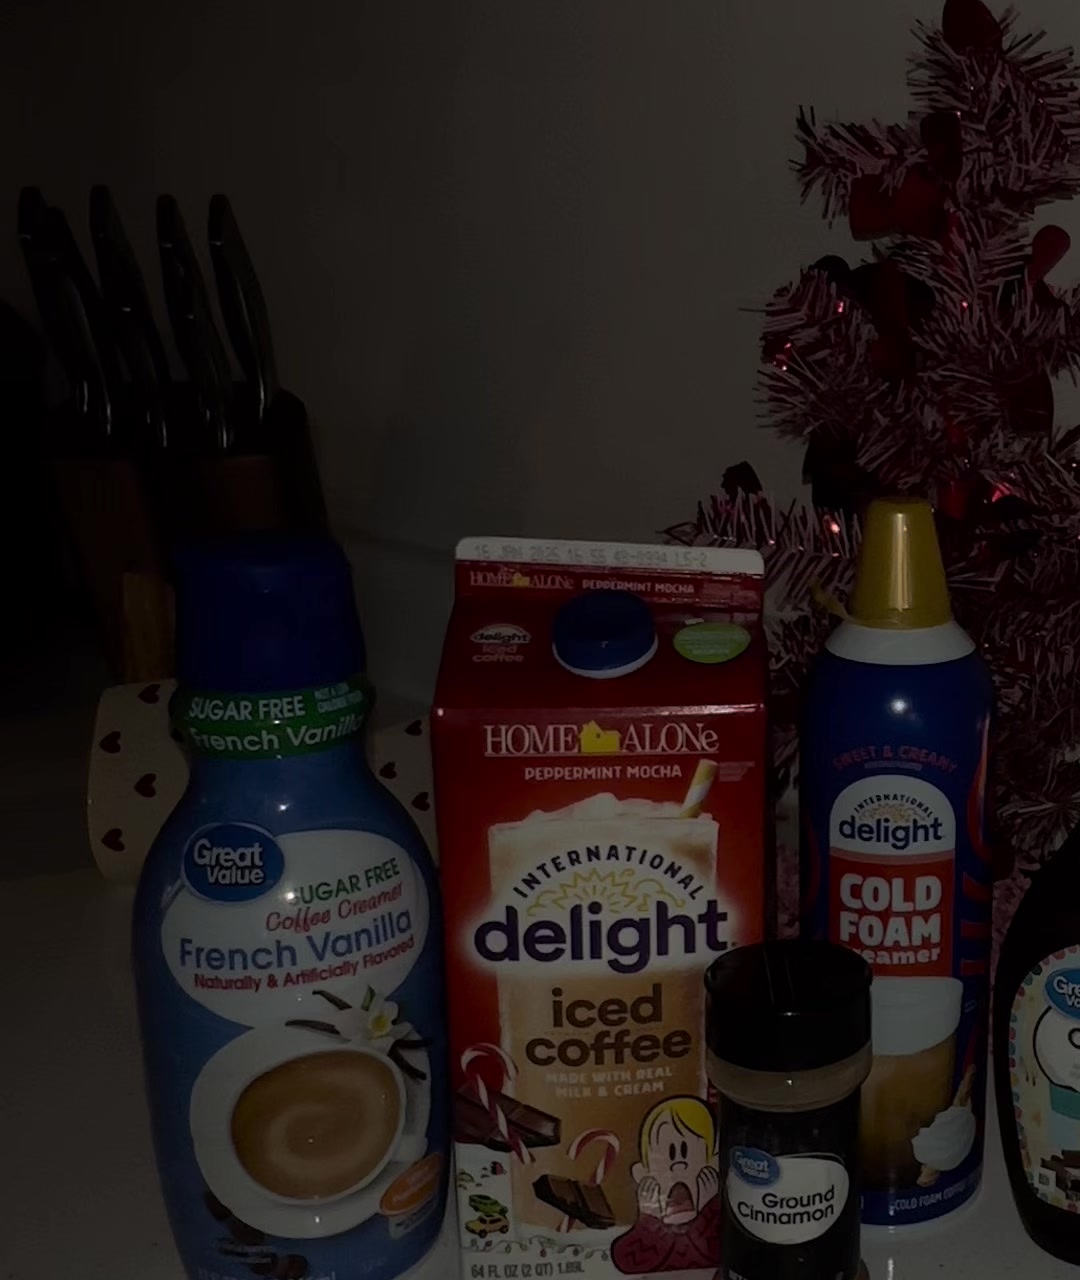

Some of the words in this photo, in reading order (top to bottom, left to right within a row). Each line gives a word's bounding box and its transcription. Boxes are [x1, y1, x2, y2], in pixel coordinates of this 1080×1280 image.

[469, 570, 513, 588] HOME
[582, 578, 652, 593] PEPPERMINT
[655, 582, 695, 594] MOCHA
[473, 632, 531, 646] delight
[188, 696, 253, 721] SUGAR
[258, 695, 306, 719] FREE
[286, 713, 364, 747] Vanilla
[484, 723, 578, 754] HOME
[524, 766, 622, 782] PEPPERMINT
[626, 764, 683, 779] MOCHA
[853, 793, 935, 818] INTERNATIONAL
[838, 815, 943, 850] delight
[193, 837, 265, 868] Great
[206, 866, 265, 886] Value
[364, 856, 401, 889] FREE
[513, 844, 705, 900] INTERNATIONAL
[265, 906, 332, 934] Coffee
[337, 881, 403, 920] Creamer
[839, 872, 943, 913] COLD
[179, 937, 298, 971] French
[306, 910, 413, 962] Vanilla
[474, 899, 728, 974] delight
[839, 910, 942, 948] FOAM
[194, 971, 262, 992] Naturally
[266, 973, 279, 989] &
[283, 959, 360, 988] Artificially
[363, 933, 415, 969] Flavored
[552, 982, 663, 1029] iced
[525, 1029, 693, 1067] coffee
[545, 1071, 589, 1085] MADE
[592, 1070, 632, 1083] WITH
[636, 1066, 673, 1080] REAL
[555, 1085, 593, 1098] MILK
[613, 1081, 665, 1097] CREAM
[761, 1184, 835, 1209] Ground
[895, 1198, 918, 1211] COLD
[737, 1202, 834, 1225] Cinnamon
[471, 1264, 485, 1279] 64
[488, 1265, 502, 1279] FL
[504, 1263, 519, 1278] OZ
[535, 1262, 554, 1277] QT)
